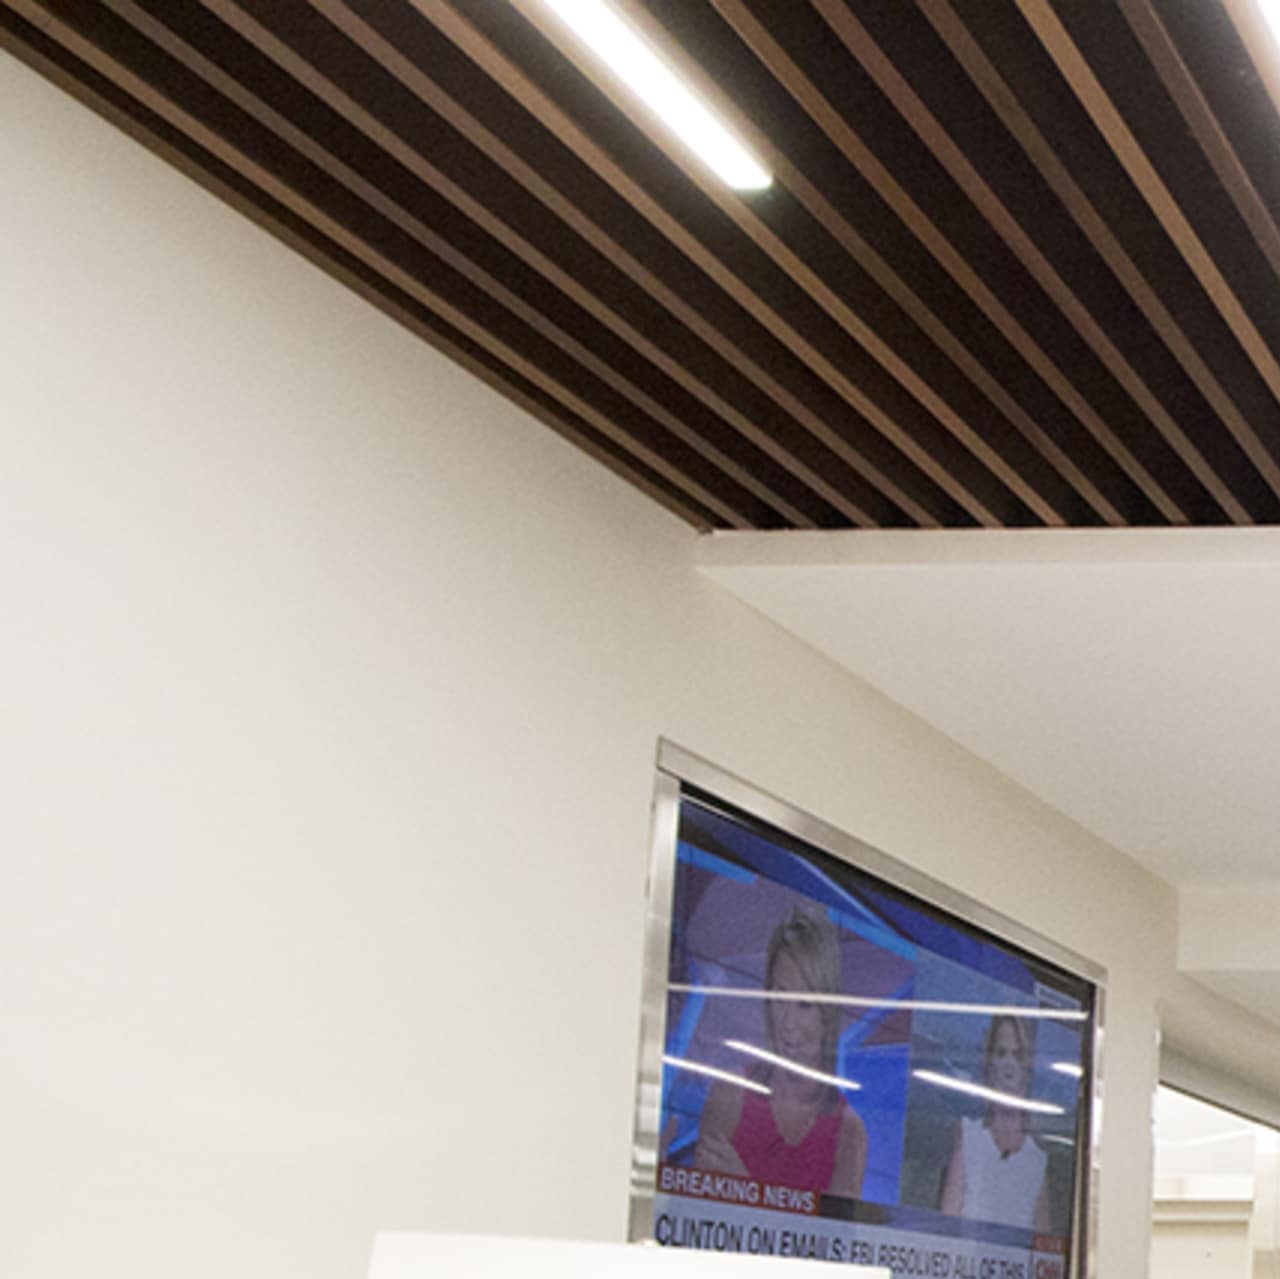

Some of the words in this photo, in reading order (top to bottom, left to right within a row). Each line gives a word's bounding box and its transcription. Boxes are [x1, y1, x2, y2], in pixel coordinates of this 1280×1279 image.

[661, 1167, 759, 1204] BREAKING
[763, 1184, 815, 1212] NEWS
[655, 1213, 744, 1251] CLINTON
[749, 1227, 776, 1255] ON
[878, 1244, 949, 1279] RESOLVED
